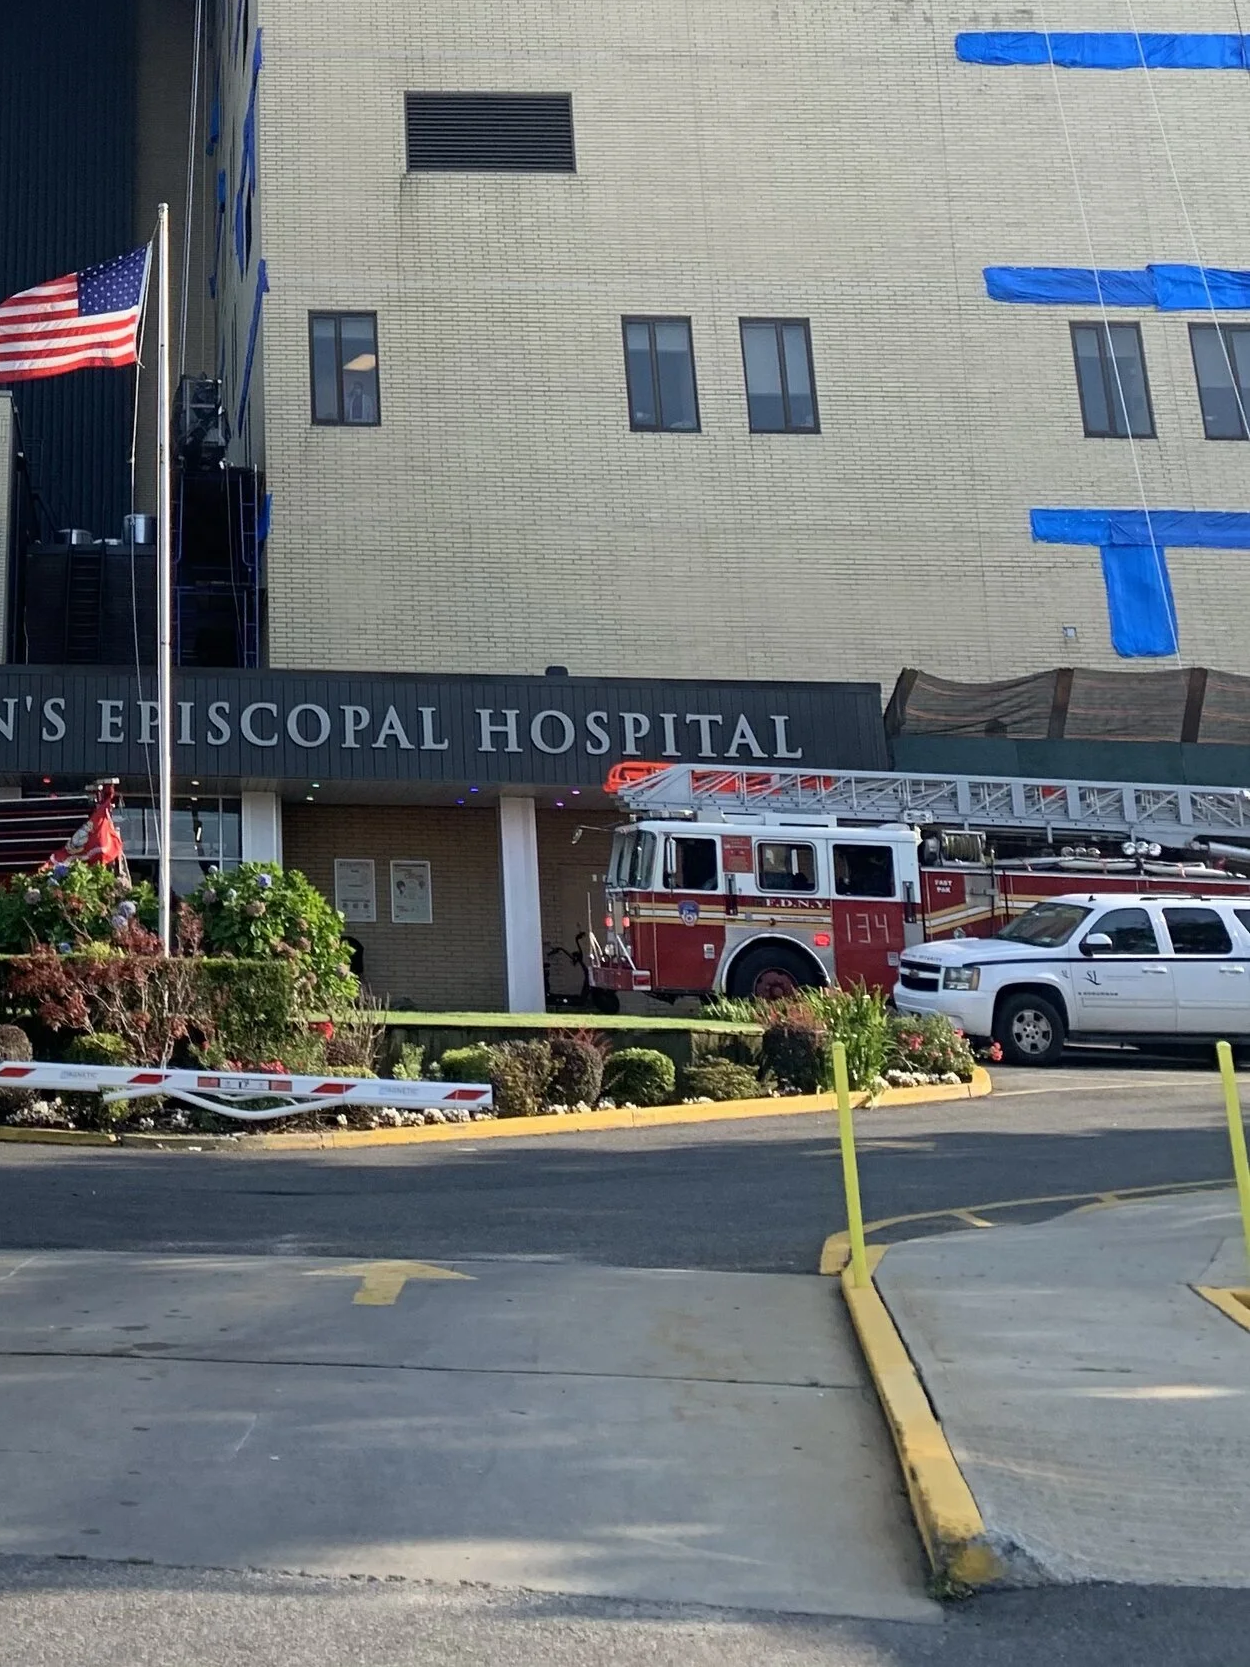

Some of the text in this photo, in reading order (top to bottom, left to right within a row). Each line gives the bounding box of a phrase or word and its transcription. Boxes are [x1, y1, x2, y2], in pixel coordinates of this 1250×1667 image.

[97, 700, 449, 750] EPISCOPAL
[475, 708, 803, 759] HOSPITAL
[846, 913, 890, 944] 134
